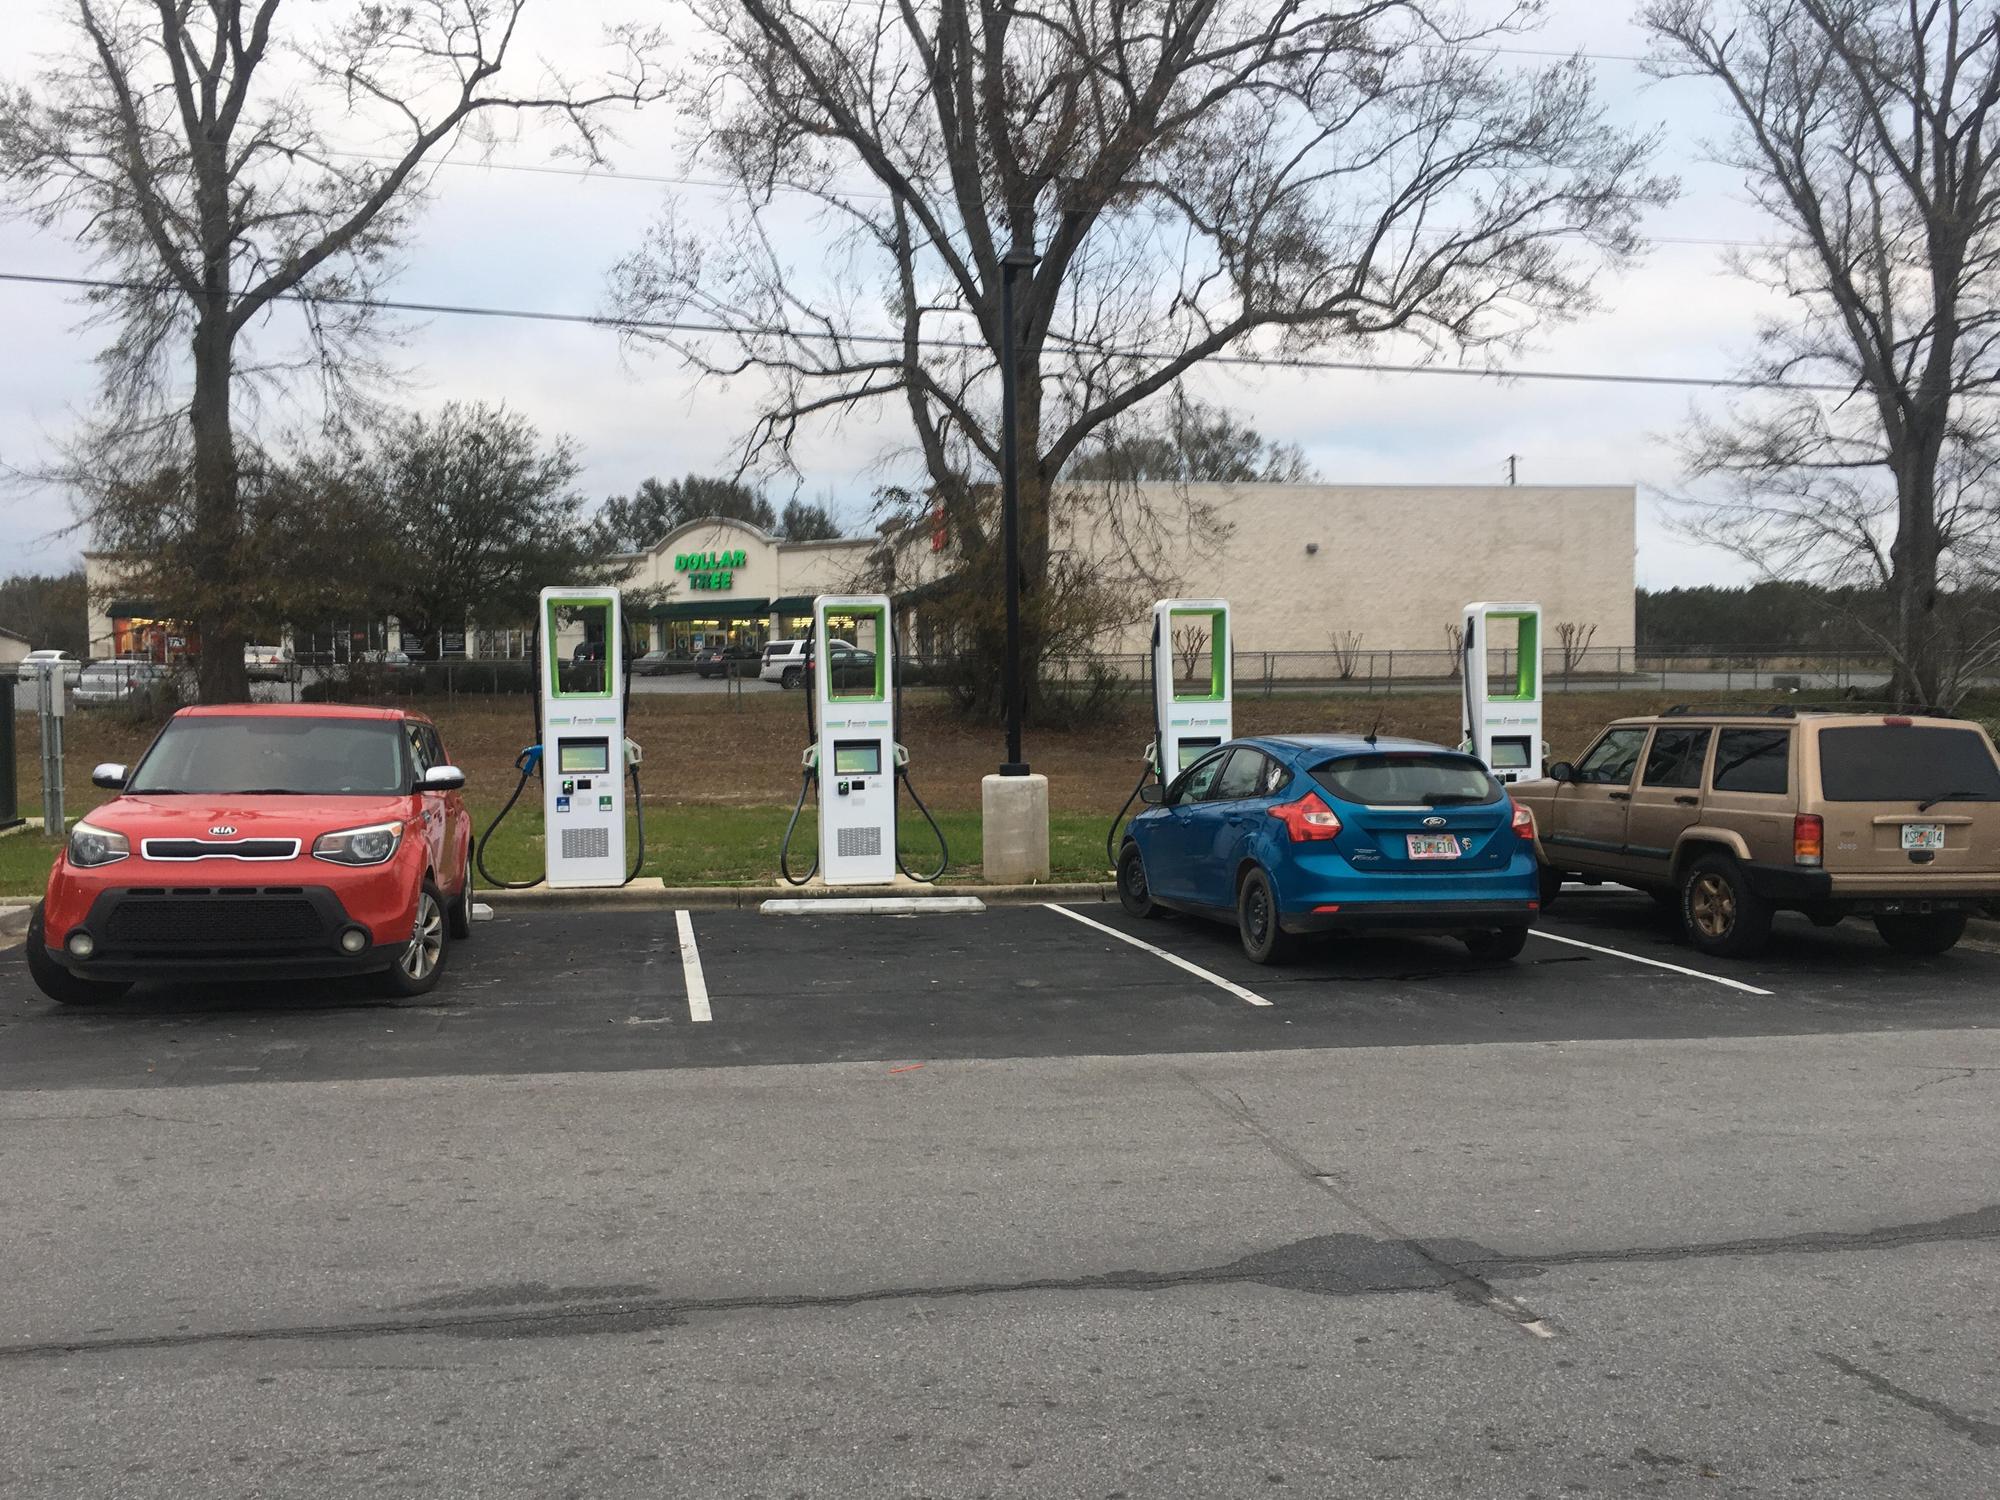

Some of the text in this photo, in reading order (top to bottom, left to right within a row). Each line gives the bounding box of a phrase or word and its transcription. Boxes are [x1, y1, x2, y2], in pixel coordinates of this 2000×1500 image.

[675, 550, 746, 571] DOLLAR
[688, 571, 733, 591] TREE
[212, 826, 232, 834] KIA
